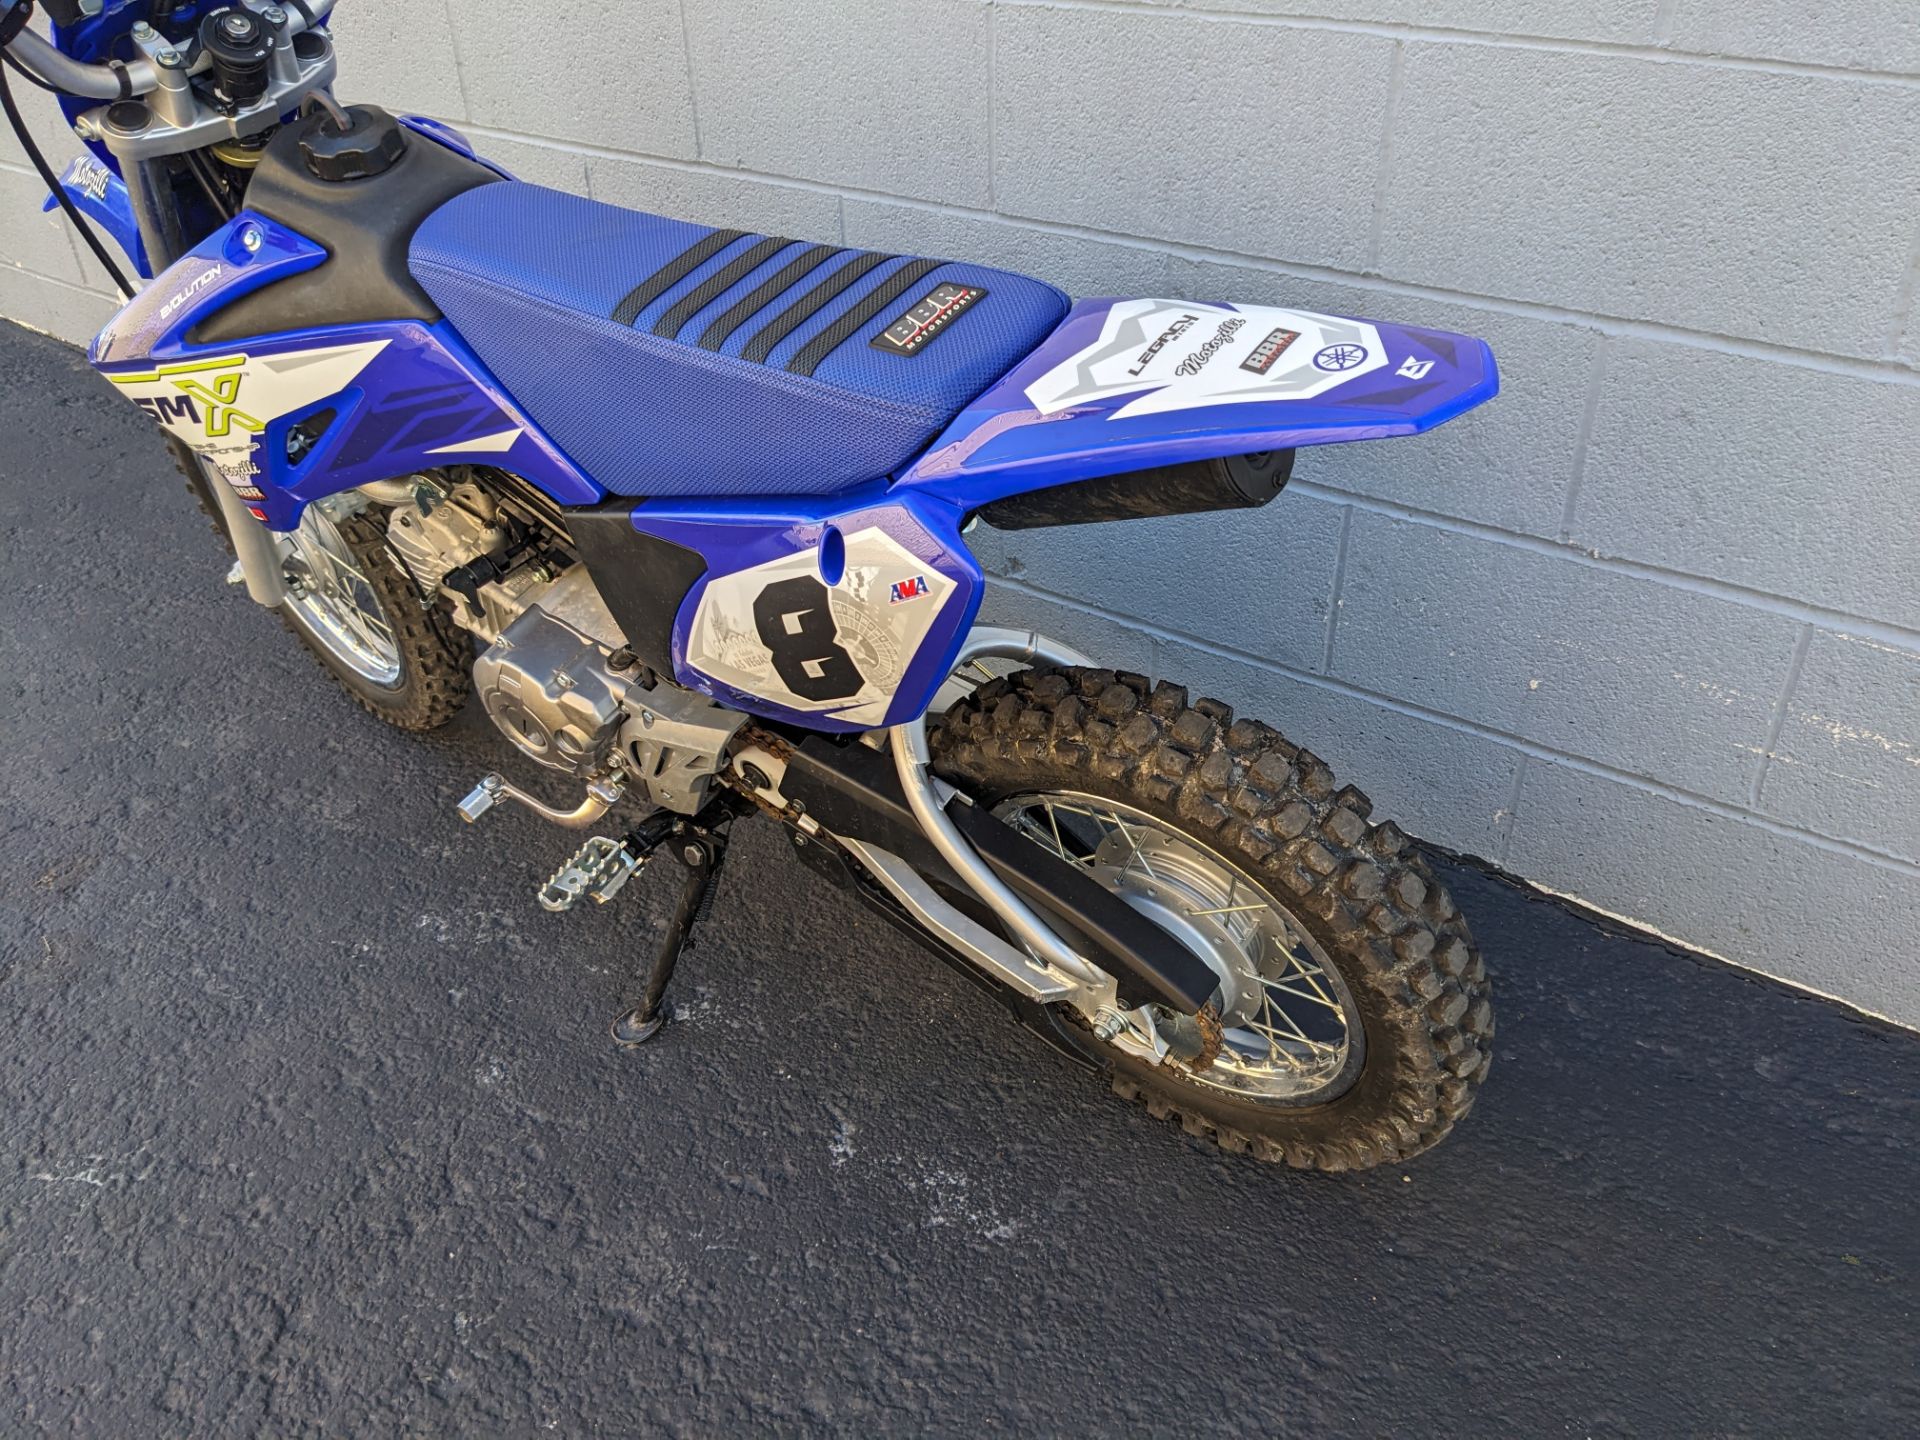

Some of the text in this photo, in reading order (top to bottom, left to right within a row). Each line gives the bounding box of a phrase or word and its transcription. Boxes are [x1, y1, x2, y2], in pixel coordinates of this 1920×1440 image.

[159, 263, 222, 320] EVOLUTION
[906, 290, 977, 350] MOTORSPORTS
[1127, 314, 1200, 377] LEGACY
[1246, 331, 1292, 369] BBR
[889, 575, 929, 603] AMA
[752, 574, 866, 702] 8
